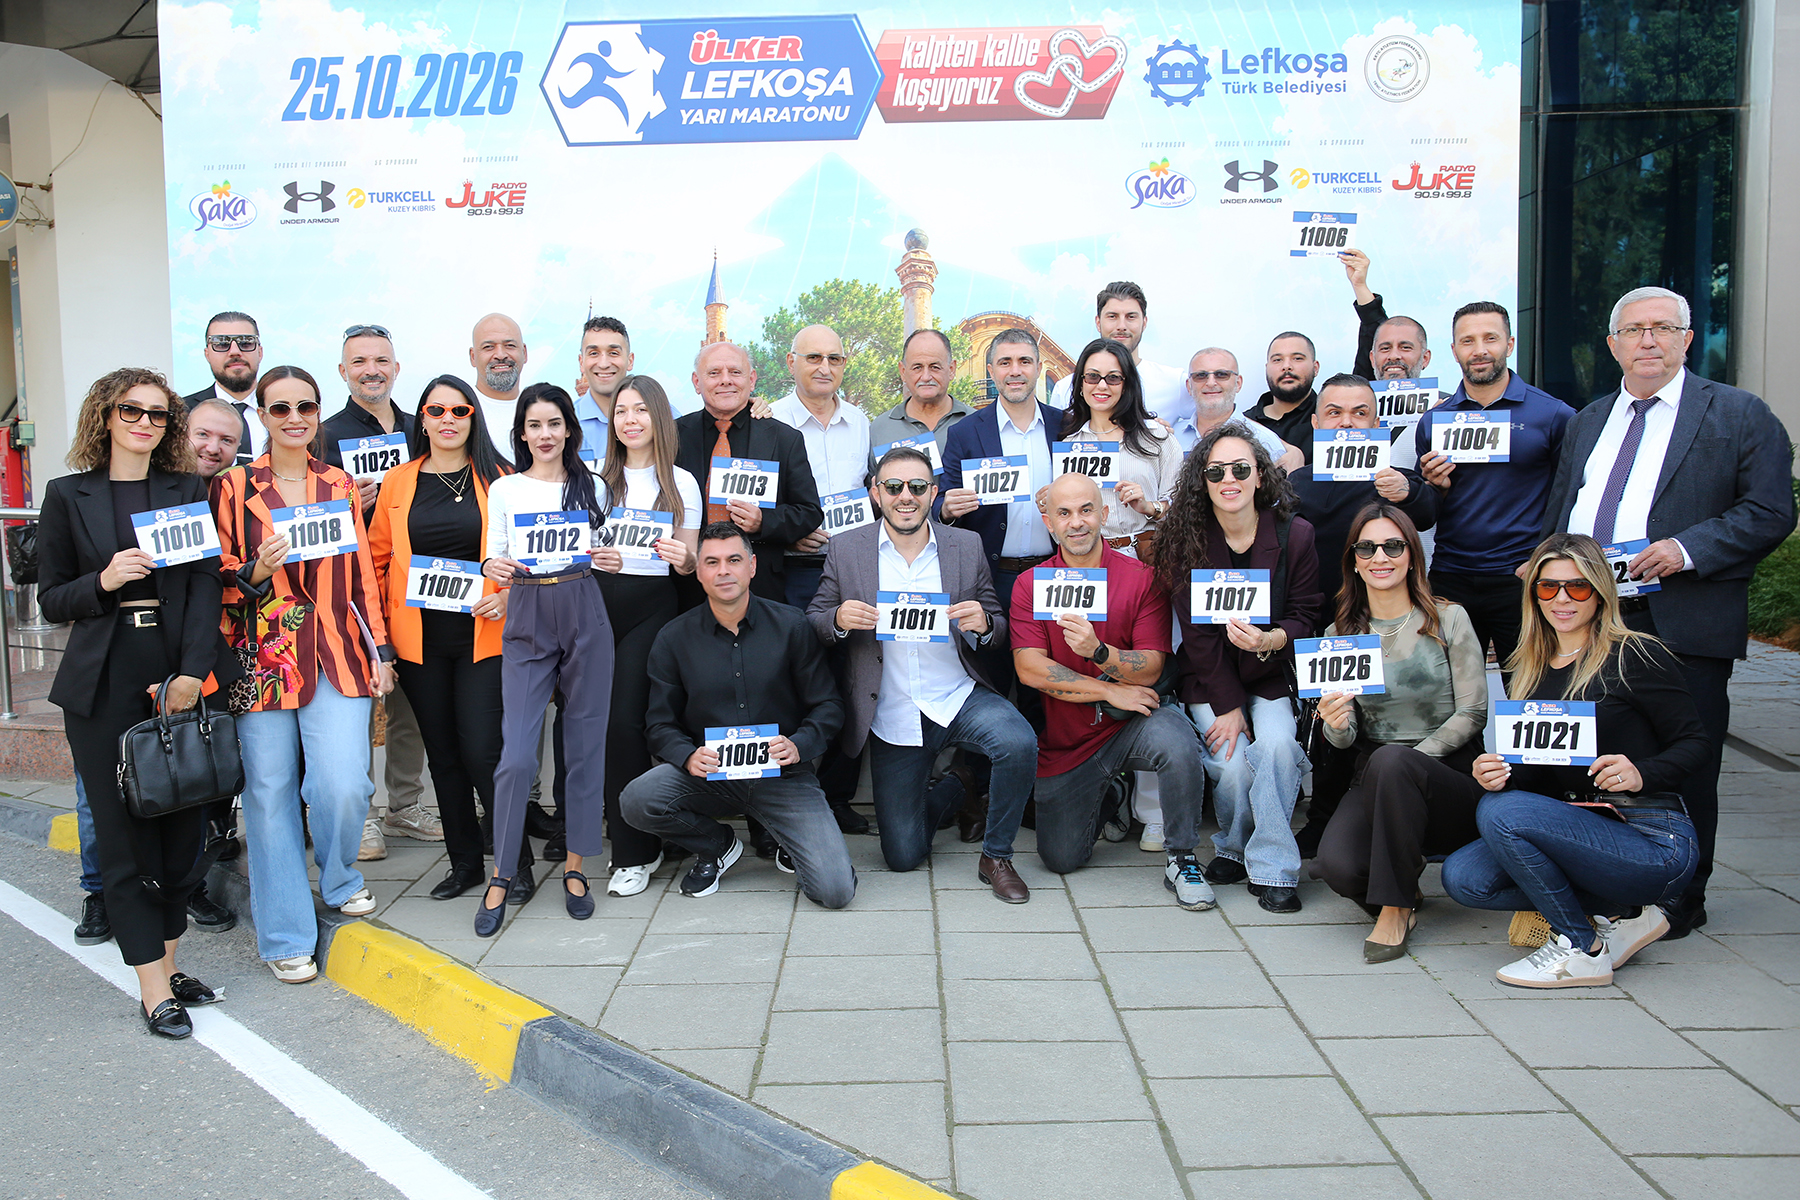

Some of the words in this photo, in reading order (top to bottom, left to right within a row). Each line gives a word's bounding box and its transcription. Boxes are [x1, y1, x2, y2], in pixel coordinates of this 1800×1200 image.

[689, 29, 803, 65] ÜLKER
[900, 35, 978, 74] kalpten
[982, 33, 1041, 67] kalbe
[1222, 47, 1348, 78] Lefkoşa
[281, 51, 524, 121] 25.10.2026
[680, 67, 854, 102] LEFKOŞA
[892, 73, 1004, 112] koşuyoruz
[1222, 82, 1257, 95] Türk
[1263, 80, 1346, 95] Belediyesi
[680, 108, 727, 125] YARI
[730, 105, 851, 123] MARATONU
[1312, 172, 1382, 184] TURKCELL
[1392, 165, 1476, 190] JUKE
[368, 190, 435, 203] TURKCELL
[445, 182, 527, 208] JUKE
[1332, 186, 1355, 194] KUZEY
[1357, 186, 1382, 194] KIBRIS
[1446, 190, 1472, 198] 99.8
[388, 205, 410, 213] KUZEY
[412, 204, 435, 212] KIBRIS
[498, 207, 524, 215] 99.8
[1300, 226, 1349, 247] 11006
[1378, 392, 1430, 417] 11005
[1442, 427, 1500, 450] 11004
[352, 448, 400, 474] 11023
[1062, 456, 1111, 477] 11028
[1326, 445, 1379, 469] 11016
[721, 472, 769, 496] 11013
[973, 470, 1020, 494] 11027
[151, 520, 205, 554] 11010
[289, 517, 342, 549] 11018
[526, 527, 580, 554] 11012
[418, 573, 473, 600] 11007
[1045, 585, 1096, 608] 11019
[1205, 587, 1257, 611] 11017
[890, 607, 936, 630] 11011
[1308, 654, 1371, 684] 11026
[1512, 721, 1580, 750] 11021
[716, 741, 770, 767] 11003
